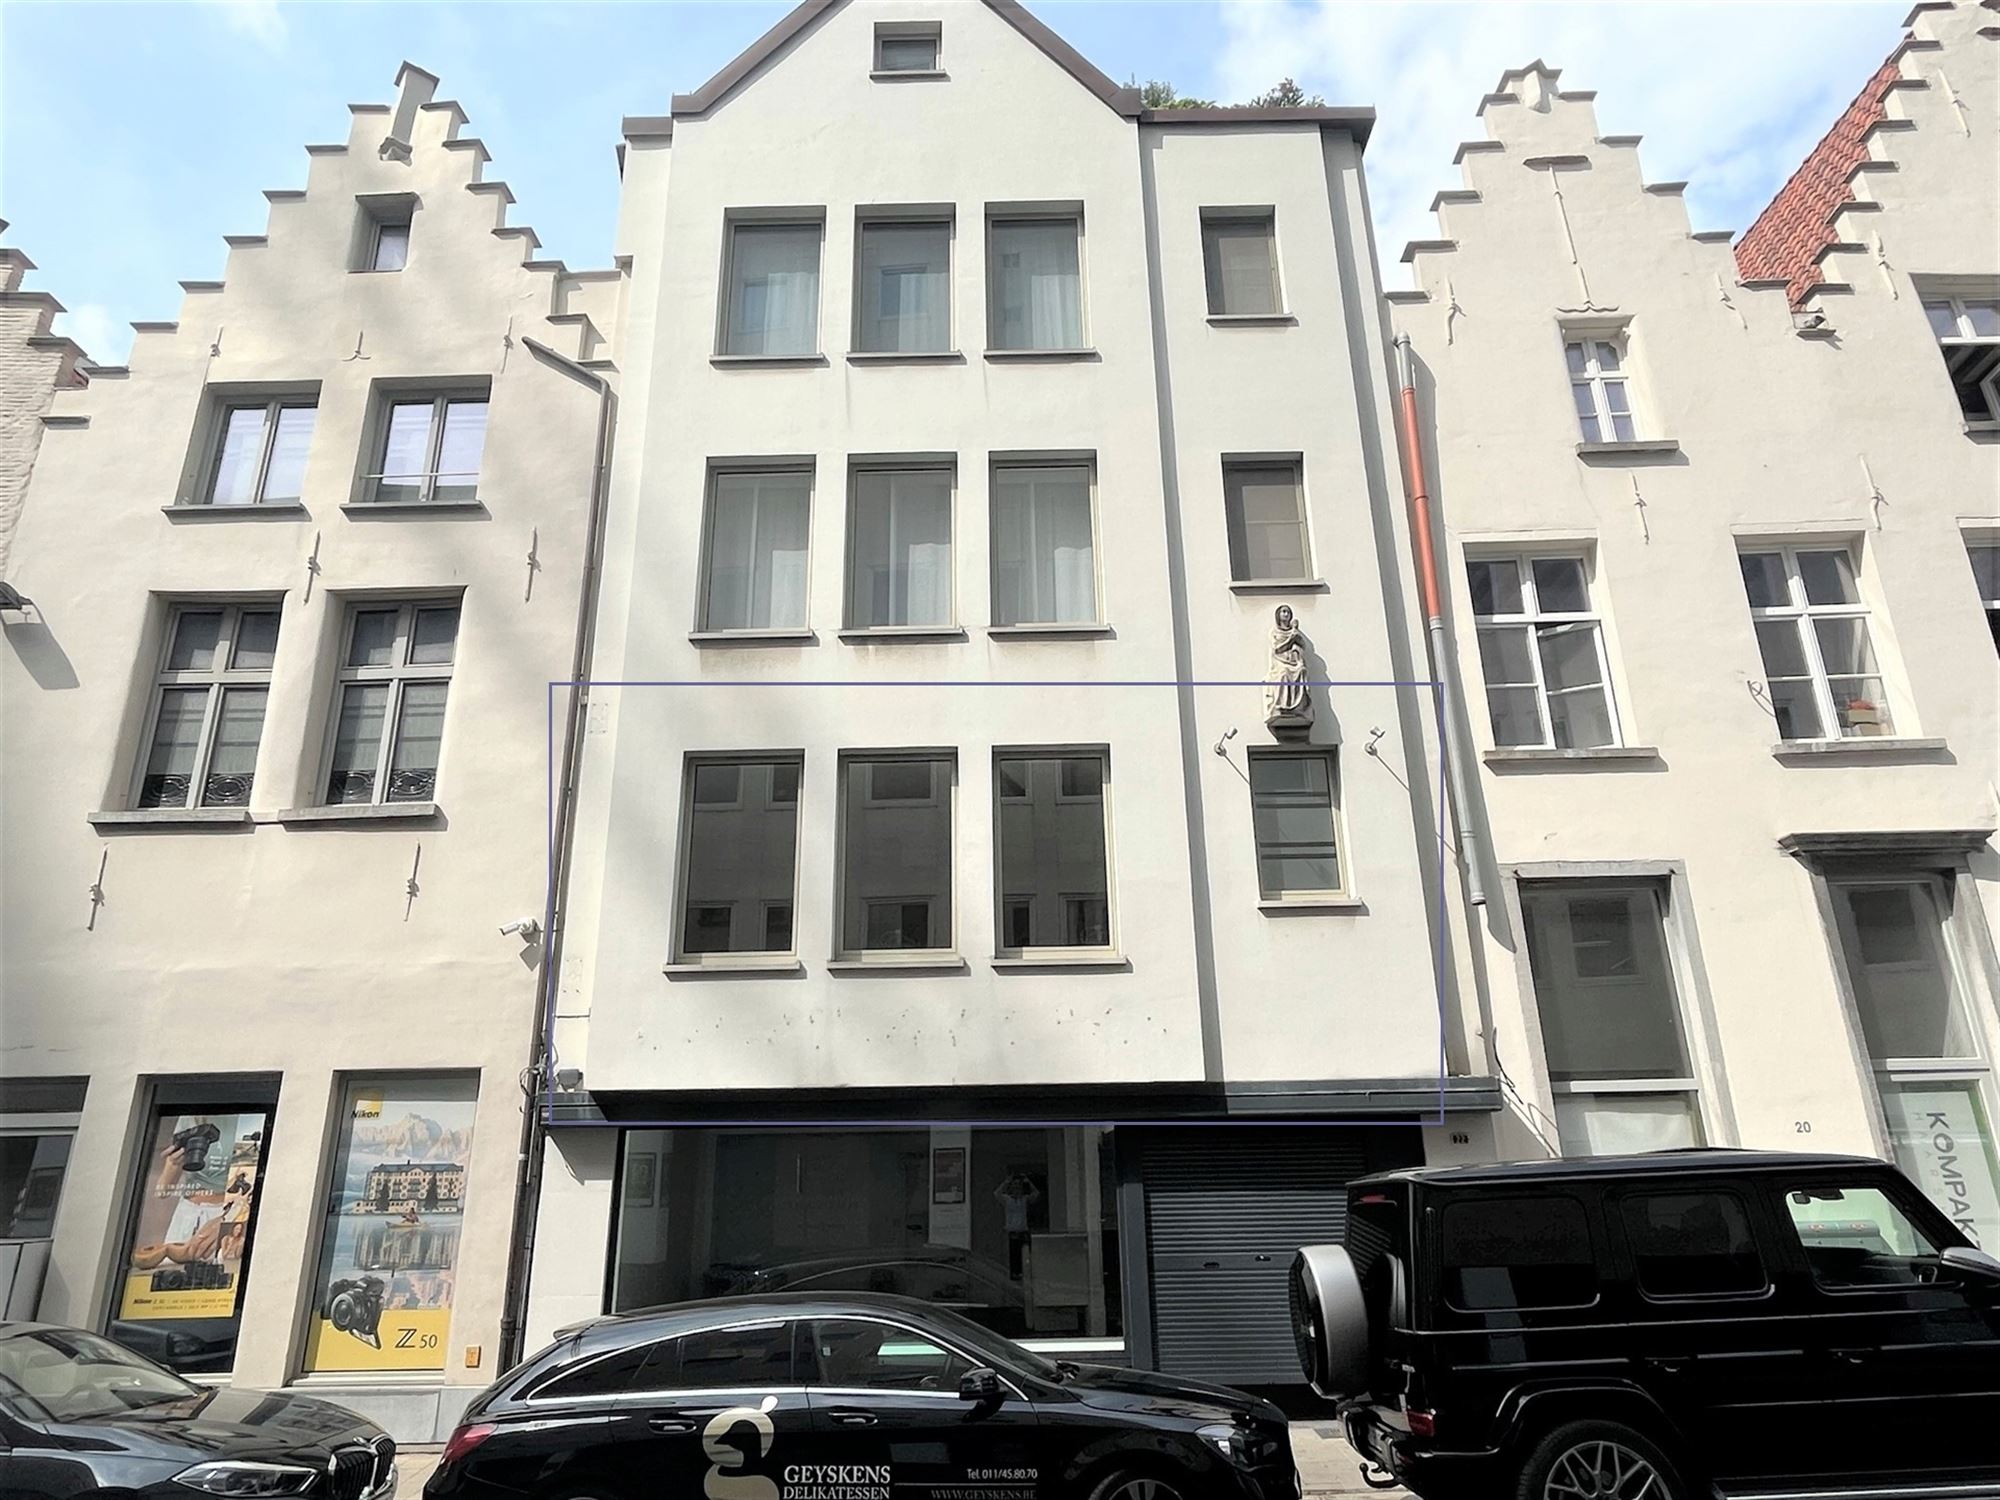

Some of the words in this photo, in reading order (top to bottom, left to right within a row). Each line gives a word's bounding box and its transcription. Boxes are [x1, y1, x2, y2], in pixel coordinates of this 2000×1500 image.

[351, 1110, 380, 1119] Nikon
[1794, 1121, 1811, 1133] 20
[395, 1328, 417, 1348] Z
[419, 1334, 438, 1349] 50
[783, 1464, 891, 1484] GEYSKENS
[981, 1468, 1038, 1479] 011/45.80.70
[783, 1486, 890, 1500] DELIKATESSEN
